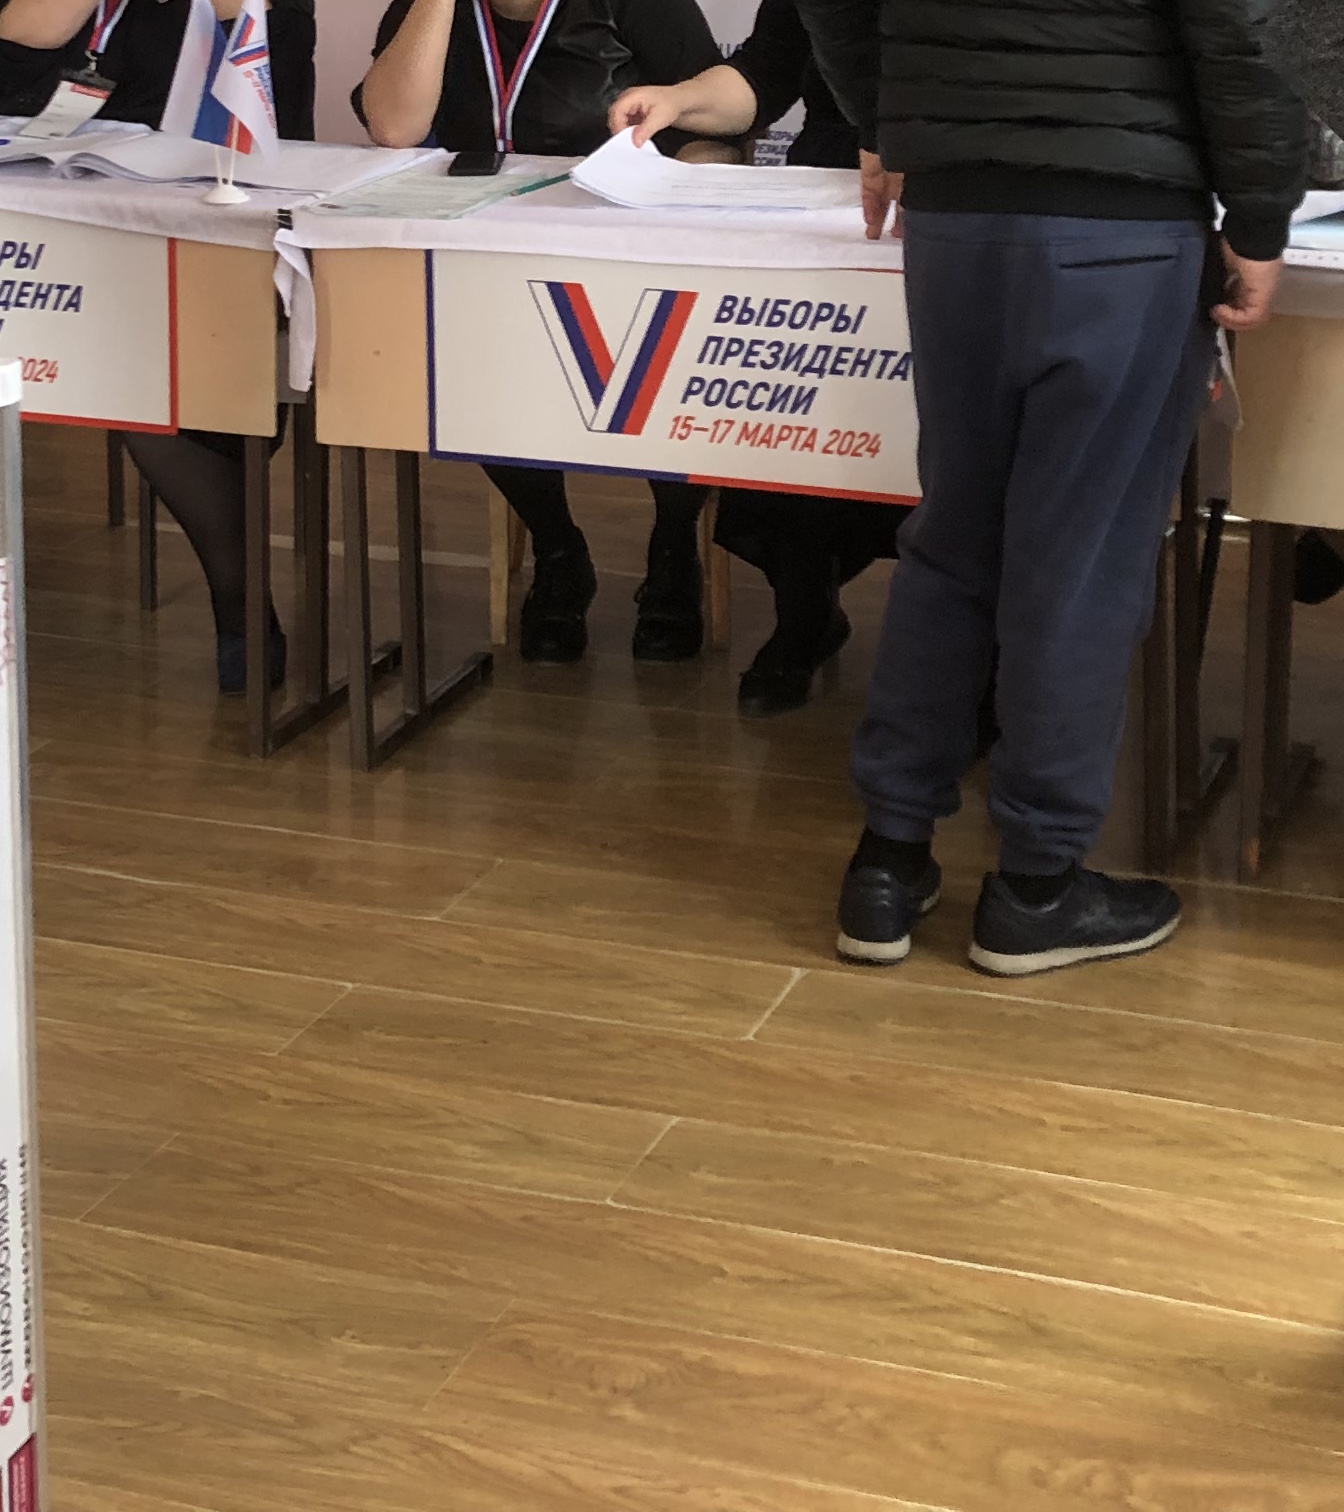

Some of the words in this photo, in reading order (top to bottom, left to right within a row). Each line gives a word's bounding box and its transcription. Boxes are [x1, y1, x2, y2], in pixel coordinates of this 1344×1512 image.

[713, 294, 867, 335] ВЫБОРЫ
[18, 356, 59, 384] 024
[696, 335, 914, 382] ПРЕЗИДЕНТА
[679, 376, 818, 417] РОССИИ
[735, 422, 818, 455] МАРТА
[821, 429, 881, 458] 2024
